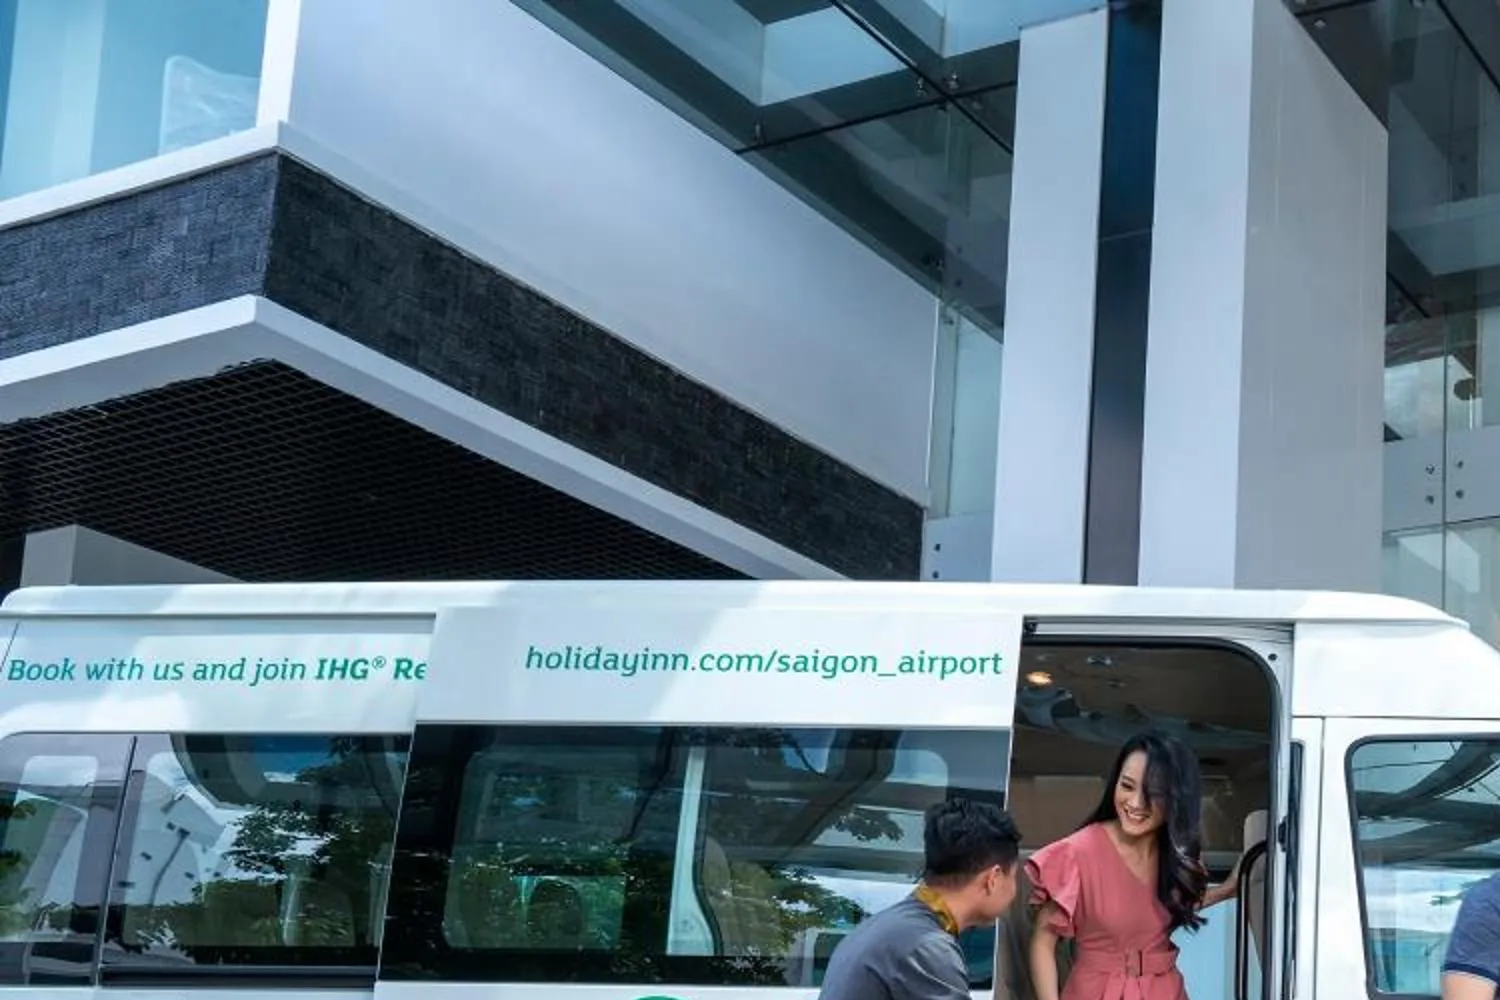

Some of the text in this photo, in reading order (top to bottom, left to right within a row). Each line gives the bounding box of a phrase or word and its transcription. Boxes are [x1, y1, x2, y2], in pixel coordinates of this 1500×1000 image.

[8, 658, 76, 681] Book
[86, 658, 144, 681] with
[153, 662, 184, 681] us
[193, 658, 245, 681] and
[249, 658, 306, 687] join
[526, 645, 1003, 680] holidayinn.com/saigon_airport
